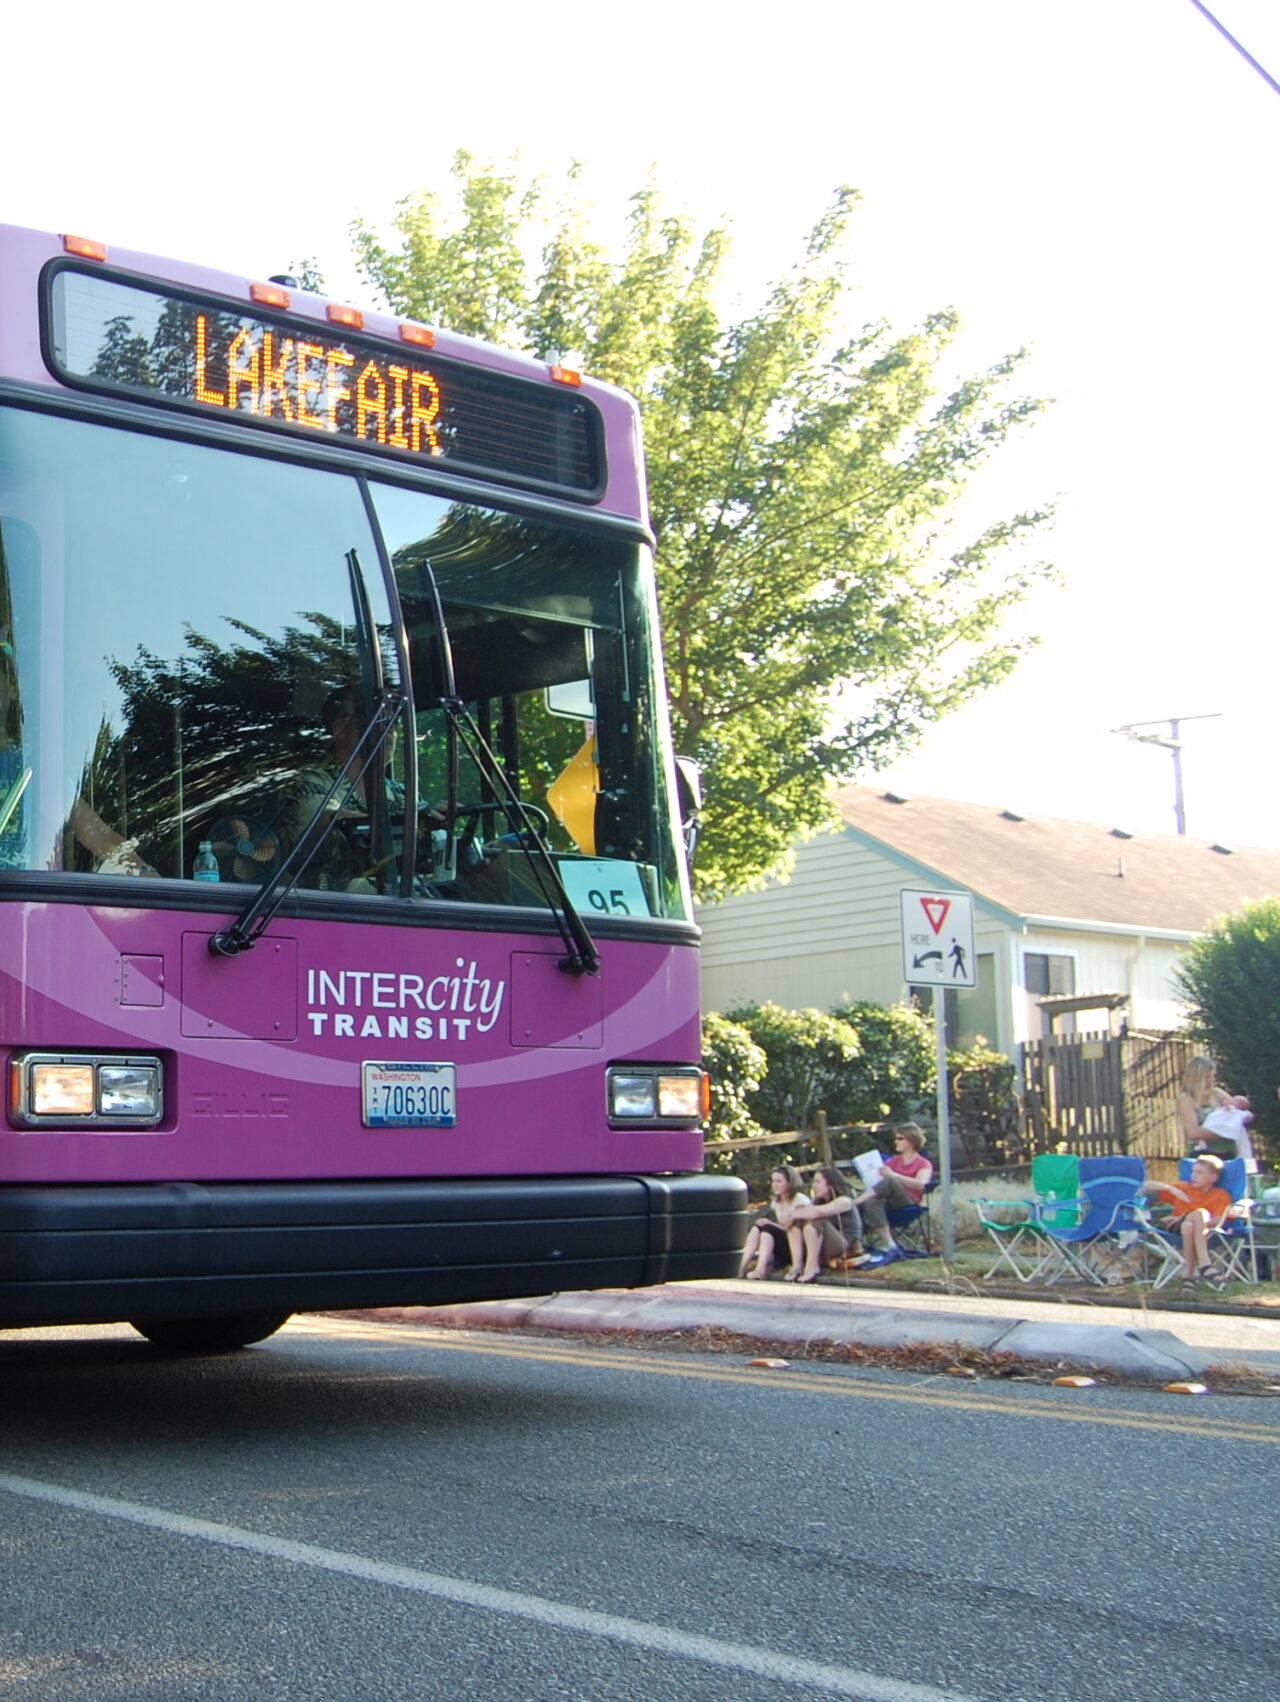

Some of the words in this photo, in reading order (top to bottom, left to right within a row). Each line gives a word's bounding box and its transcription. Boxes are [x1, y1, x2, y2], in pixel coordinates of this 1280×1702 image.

[196, 314, 444, 457] LAKEFAIR
[588, 889, 630, 916] 95
[307, 957, 505, 1032] INTERcity
[308, 1013, 471, 1041] TRANSIT
[372, 1073, 421, 1081] WASHINGTON
[381, 1085, 451, 1115] 70630C
